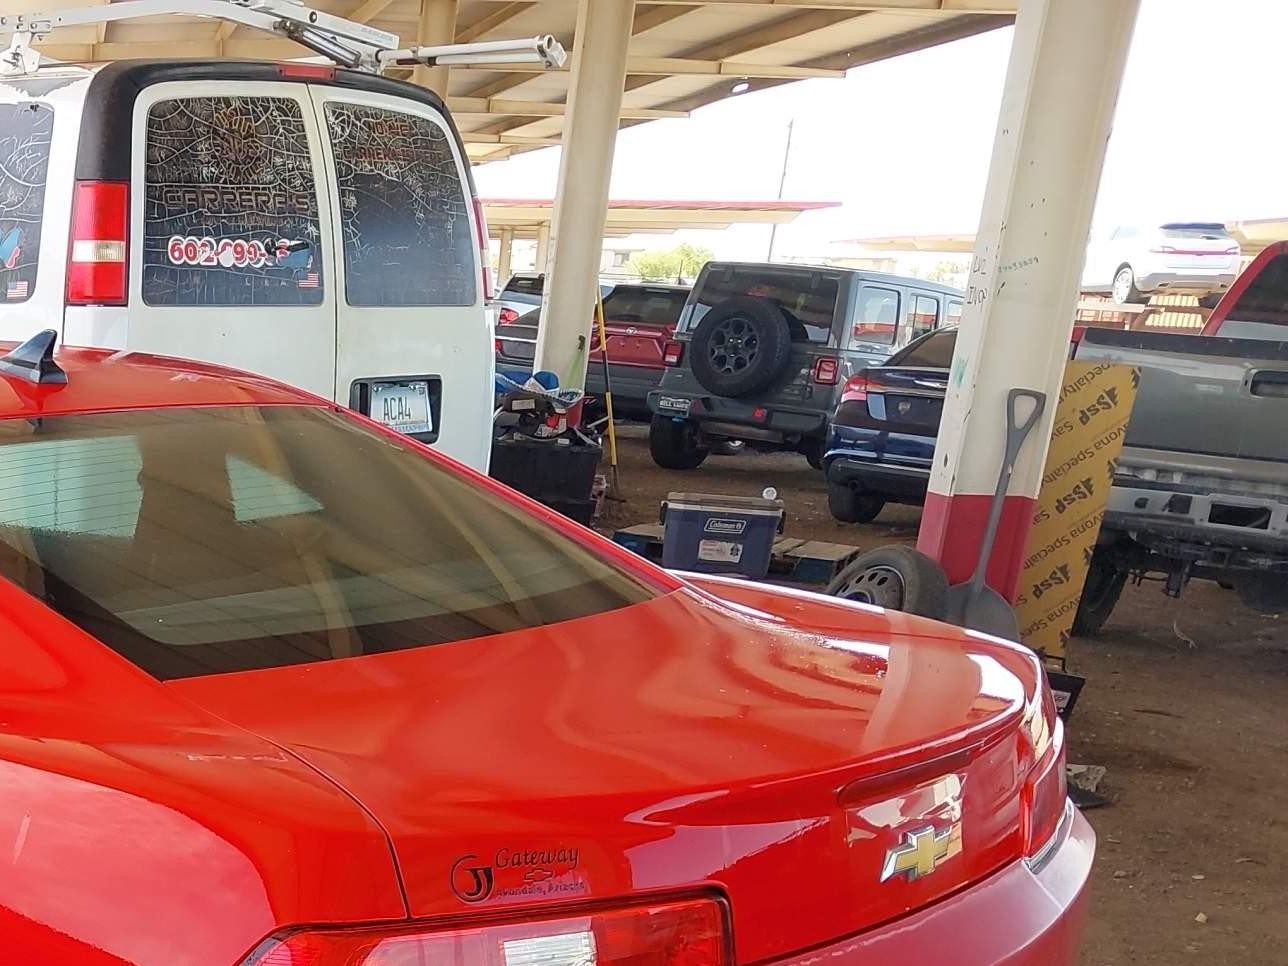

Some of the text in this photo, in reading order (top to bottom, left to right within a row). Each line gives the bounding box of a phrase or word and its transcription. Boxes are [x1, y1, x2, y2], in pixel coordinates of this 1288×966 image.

[1062, 362, 1111, 398] pecialty
[383, 397, 411, 421] ACA4
[1051, 421, 1074, 441] Sav
[495, 847, 579, 870] Gateway
